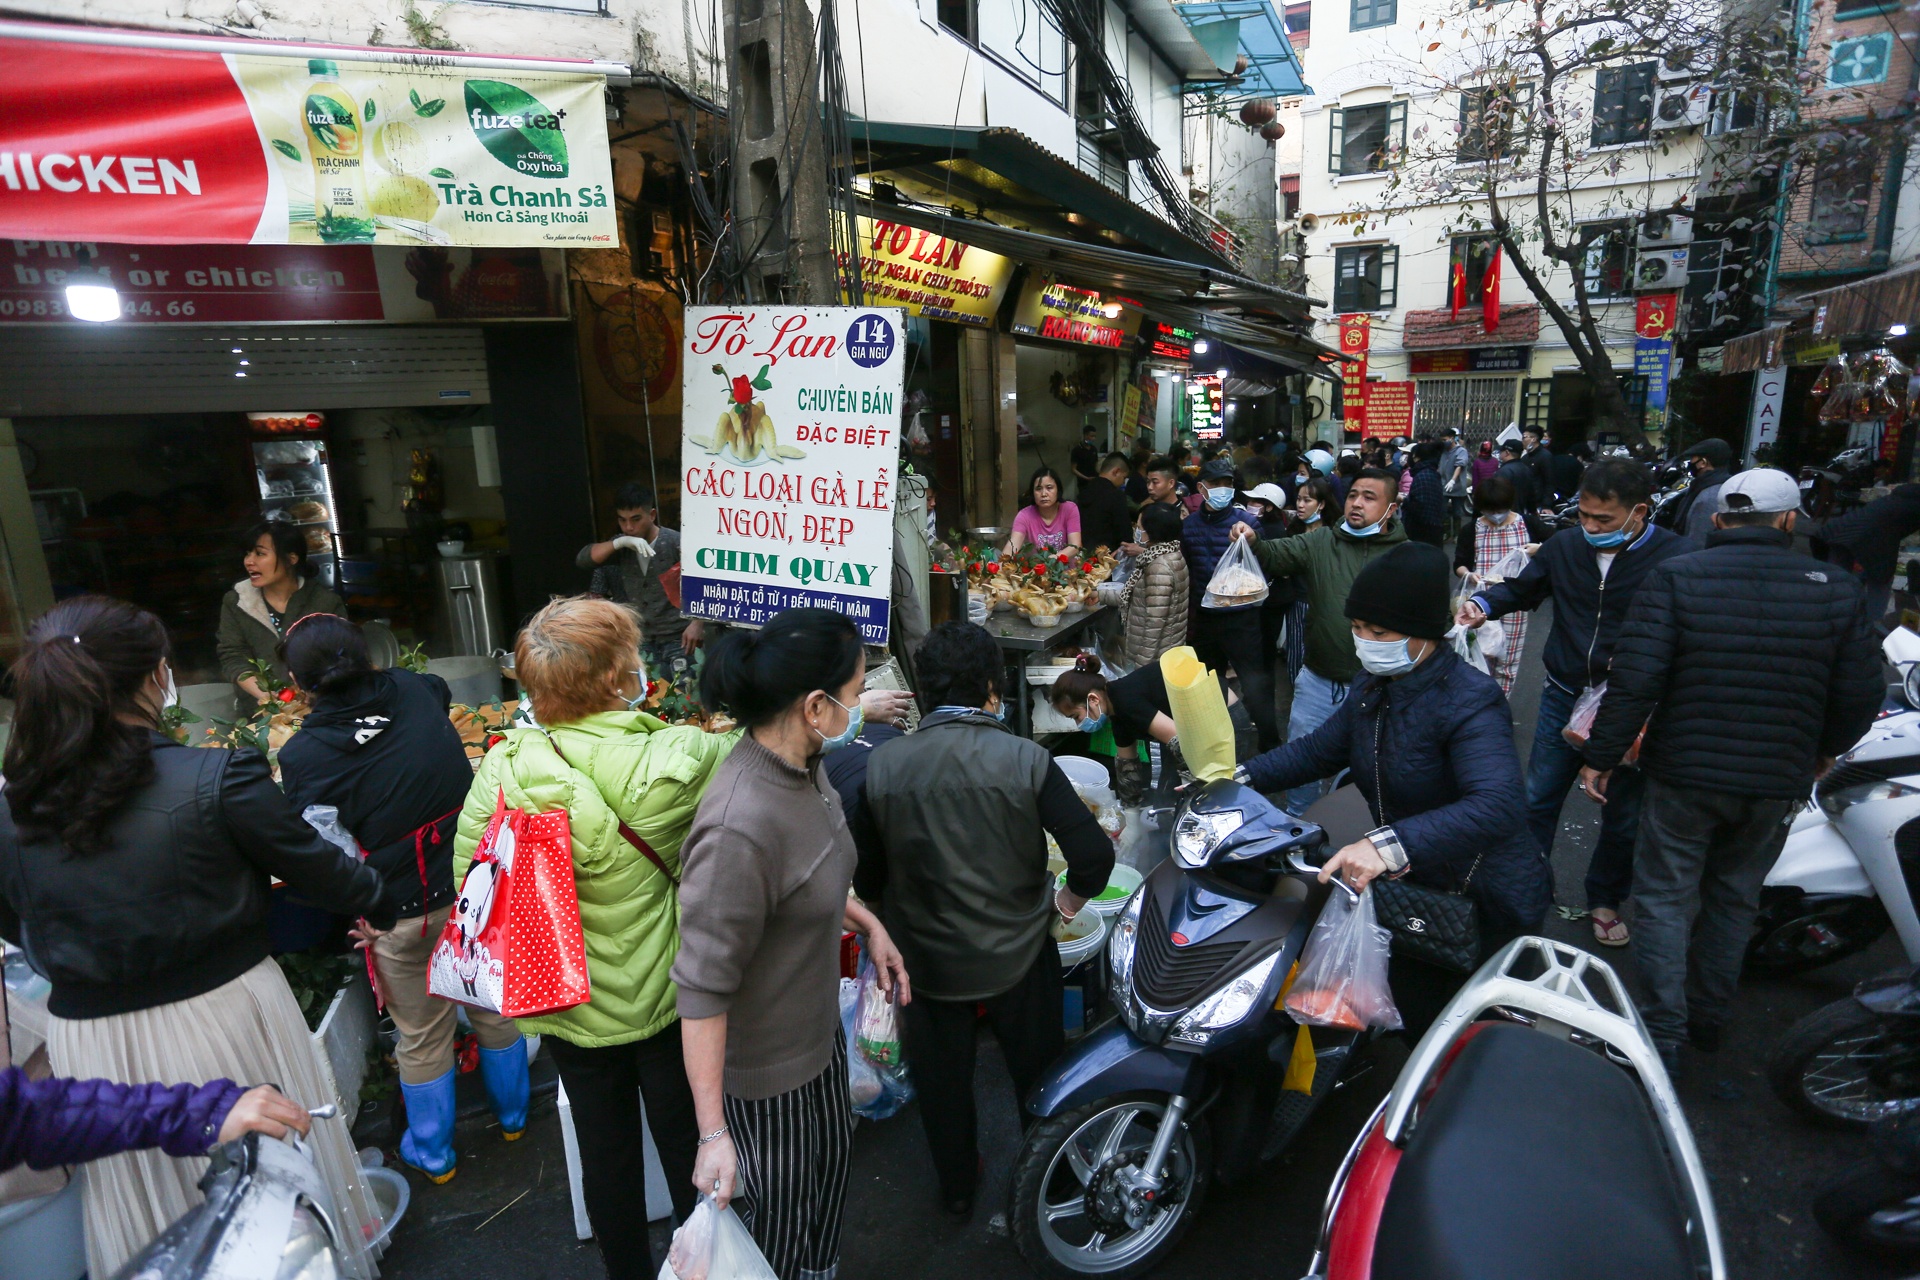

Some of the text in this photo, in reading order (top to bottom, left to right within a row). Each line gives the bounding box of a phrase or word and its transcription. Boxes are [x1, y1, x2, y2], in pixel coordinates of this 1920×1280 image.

[316, 156, 360, 168] TRÀ CHANH
[517, 161, 563, 173] Oxy hoá
[528, 152, 553, 162] Chống
[437, 183, 608, 208] Trà Chanh Sả
[464, 210, 589, 227] Hơn Cả Sảng Khoái
[128, 269, 170, 287] or
[184, 267, 346, 287] chicken
[691, 313, 755, 356] Tố
[753, 314, 839, 367] Lan
[854, 319, 887, 344] 14
[851, 345, 889, 360] GIA NGƯ
[797, 384, 893, 415] CHUYÊN BÁN
[1758, 381, 1779, 450] CAF
[796, 422, 891, 449] ĐẶC BIỆT
[686, 461, 890, 511] CÁC LOẠI GÀ LỄ
[717, 507, 855, 551] NGON, ĐẸP
[695, 547, 878, 588] CHIM QUAY
[690, 600, 705, 615] GIÁ
[708, 602, 726, 617] HỢP
[728, 604, 741, 619] LÝ
[750, 609, 765, 622] ĐT:
[703, 584, 728, 600] NHẬN
[752, 585, 764, 605] CỖ
[767, 591, 779, 606] TỪ
[782, 595, 787, 607] 1
[791, 592, 811, 609] ĐẾN
[846, 600, 870, 618] MÂM
[861, 623, 883, 639] 1977
